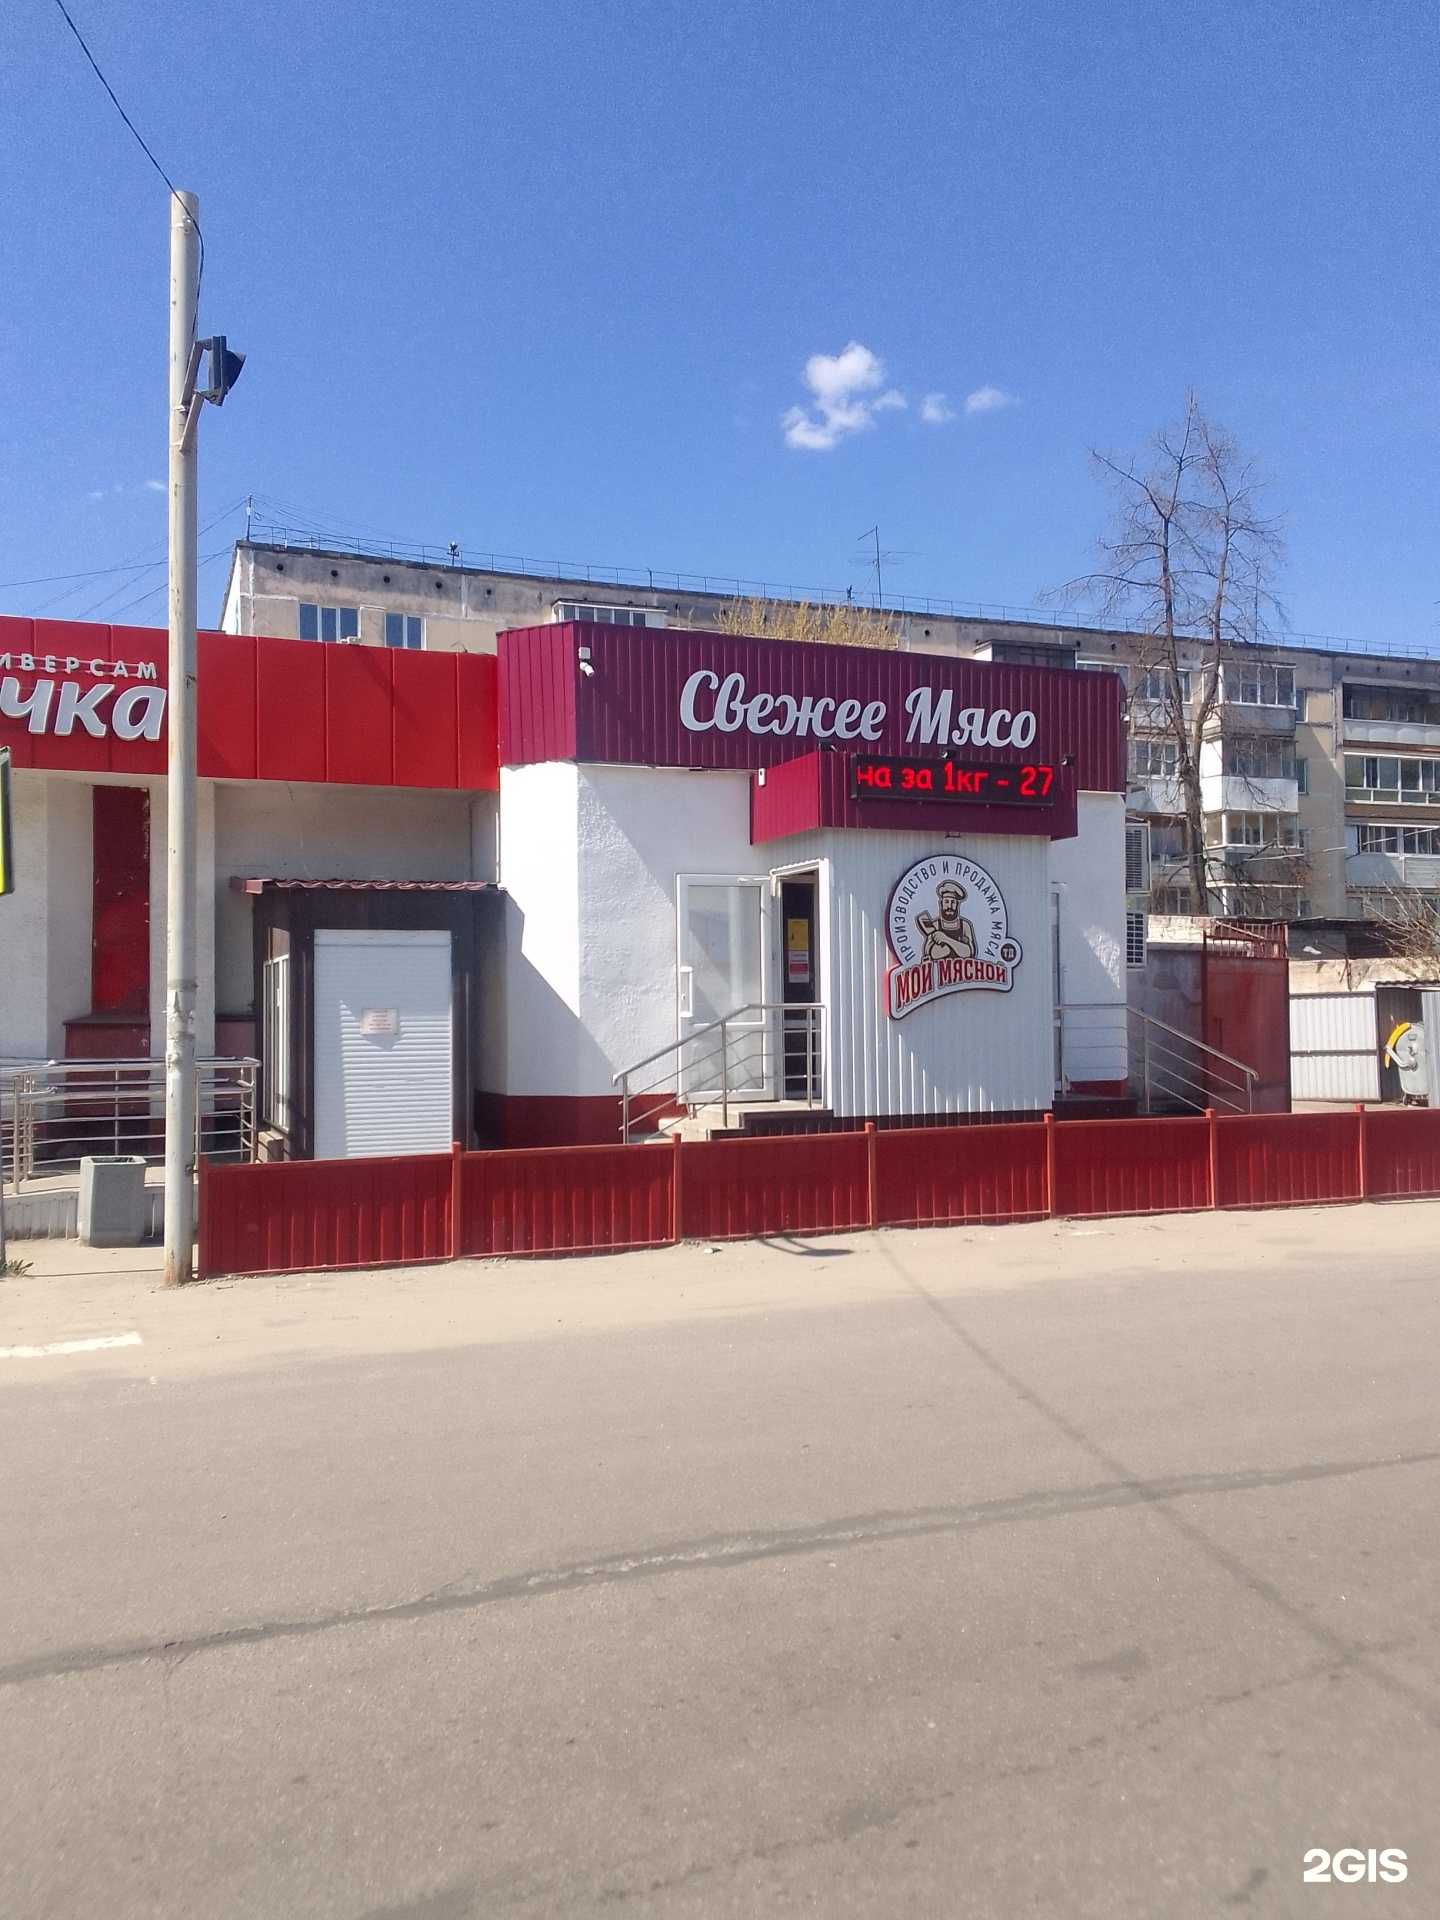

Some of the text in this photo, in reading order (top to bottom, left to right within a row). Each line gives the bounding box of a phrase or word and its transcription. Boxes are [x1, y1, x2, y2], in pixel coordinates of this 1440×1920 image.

[679, 669, 1037, 749] Свежее Мясо
[901, 767, 933, 790] за
[944, 761, 989, 793] 1кг
[1020, 765, 1054, 797] 27
[894, 860, 1003, 963] ПРОИЗВОДСТВО И ПРОДАЖА МЯСА
[895, 958, 1008, 1009] МОЙ МЯСНОЙ
